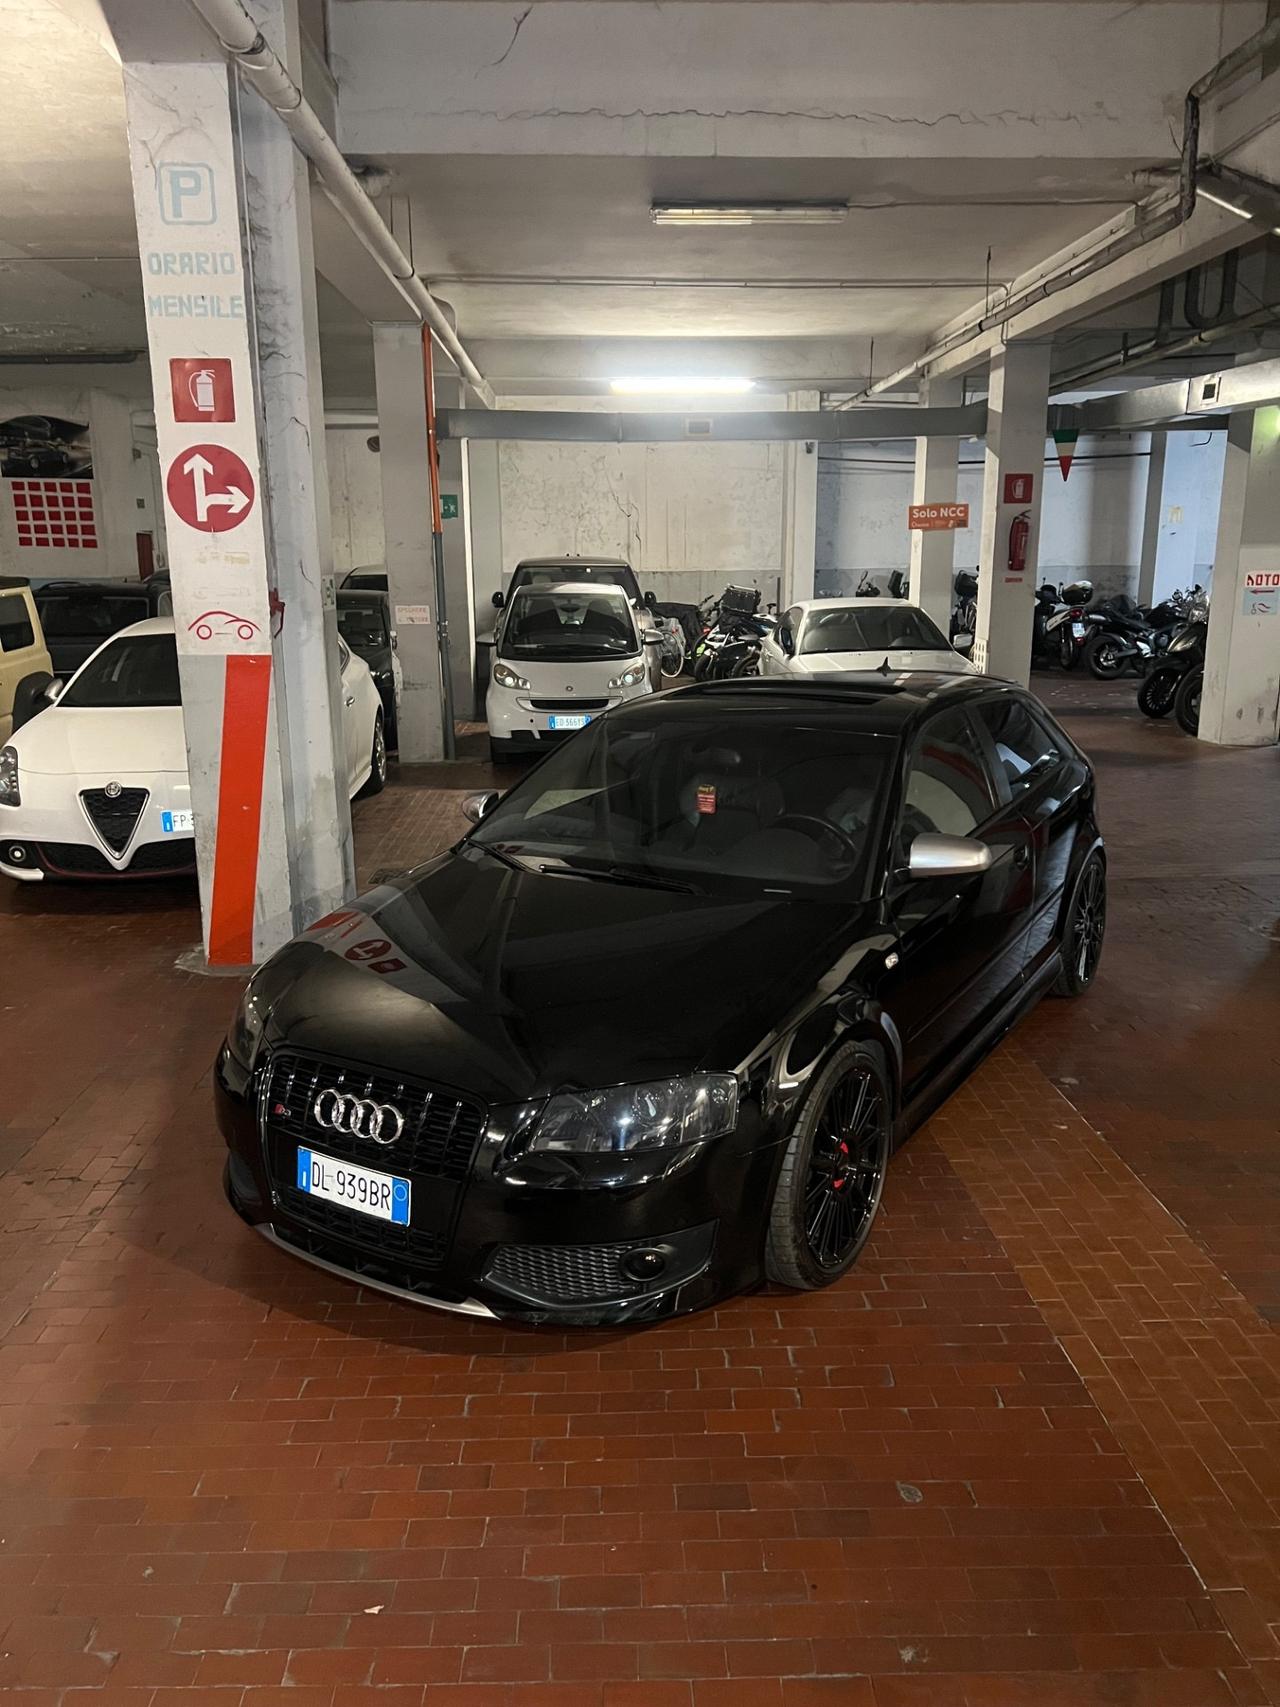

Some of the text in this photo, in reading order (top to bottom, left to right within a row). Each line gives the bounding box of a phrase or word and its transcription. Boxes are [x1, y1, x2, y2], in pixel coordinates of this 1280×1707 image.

[168, 169, 201, 218] P
[147, 252, 236, 276] ORARIO
[148, 294, 245, 318] MENSILE
[912, 506, 965, 518] Solo NCC
[312, 1161, 330, 1191] DL
[336, 1169, 391, 1211] 939BR
